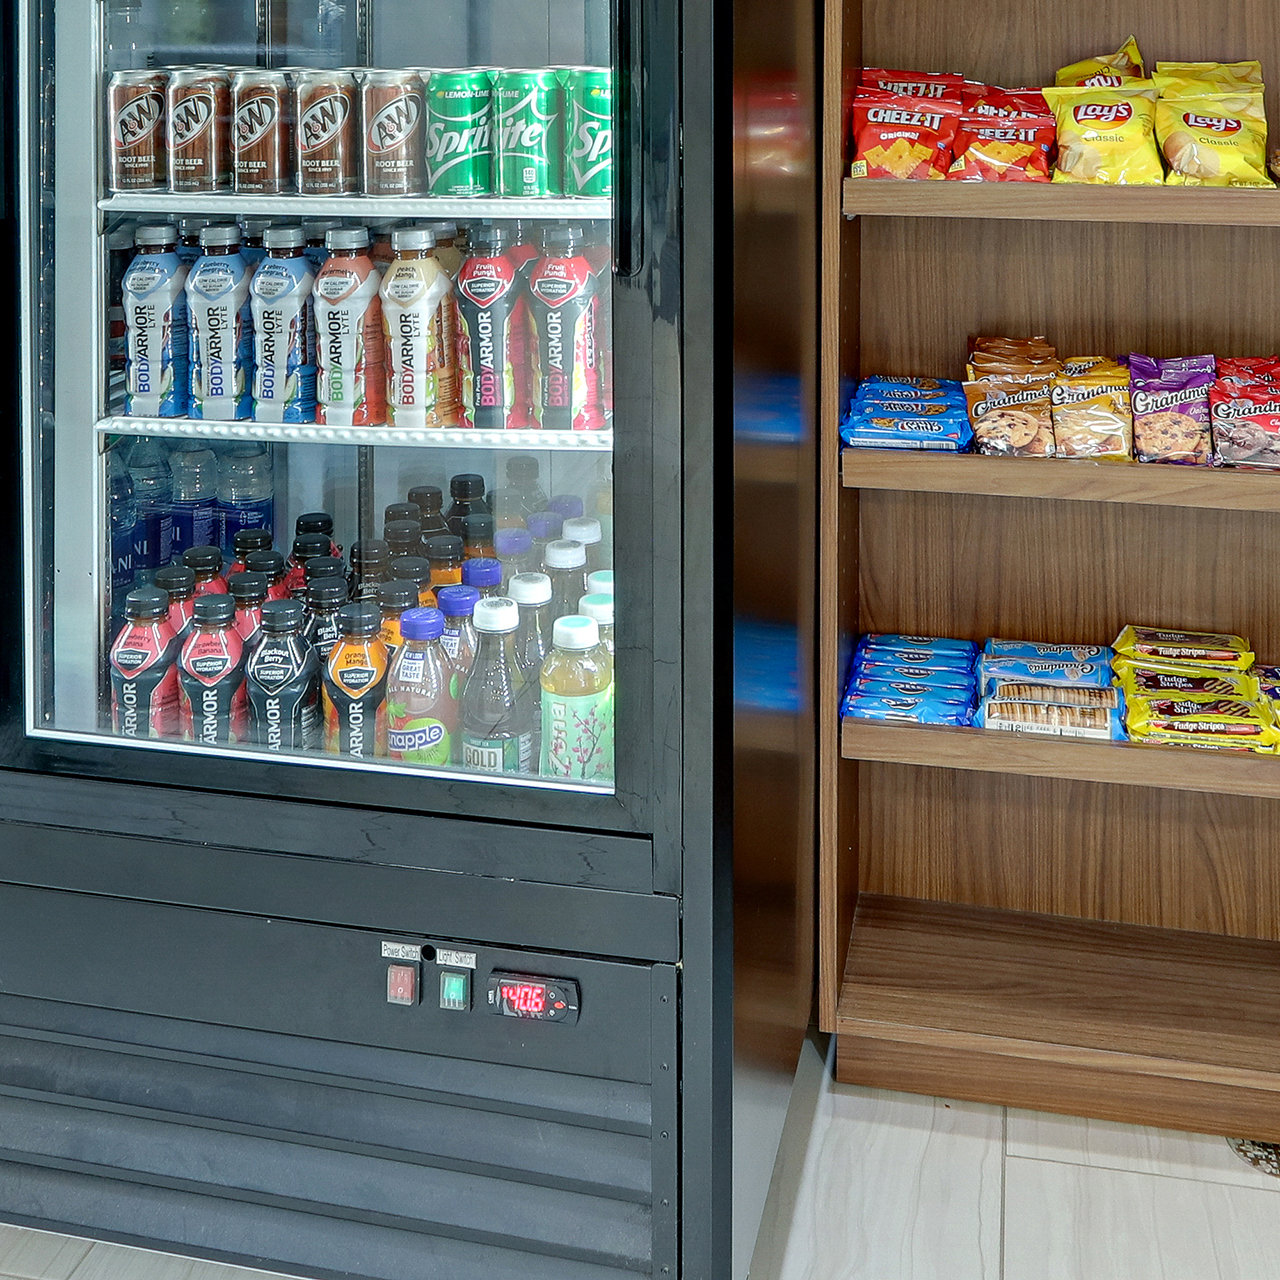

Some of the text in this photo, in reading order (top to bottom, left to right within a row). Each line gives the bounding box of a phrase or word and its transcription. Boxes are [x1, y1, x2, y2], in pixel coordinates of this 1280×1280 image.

[120, 94, 154, 148] A&W
[303, 98, 339, 148] A&W
[375, 97, 414, 150] A&W
[868, 108, 945, 128] CHEEZ-IT
[1076, 103, 1130, 121] Lay's
[426, 116, 491, 162] Sprit
[880, 132, 920, 141] ORIGINAL
[1199, 137, 1239, 147] Classic
[147, 305, 156, 329] LYTE
[220, 305, 228, 330] LYTE
[275, 310, 283, 334] LYTE
[342, 310, 350, 335] LYTE
[134, 305, 150, 393] BODYARMOR
[207, 307, 224, 396] BODYARMOR
[262, 310, 275, 399] BODYARMOR
[329, 310, 344, 401] BODYARMOR
[399, 312, 415, 405] BODYARMOR
[477, 311, 494, 407] BODYARMOR
[546, 311, 562, 407] BODYARMOR
[973, 385, 1050, 417] Grandma's
[260, 648, 289, 658] Blackout
[264, 654, 283, 664] Berry
[1159, 648, 1206, 657] Fudge Stripes
[1158, 675, 1187, 683] Fudge
[400, 686, 435, 699] NATURAL
[1174, 722, 1225, 731] Fudge Stripes
[465, 748, 497, 767] GOLD
[384, 944, 418, 958] Power Switch
[439, 951, 473, 964] Light Switch
